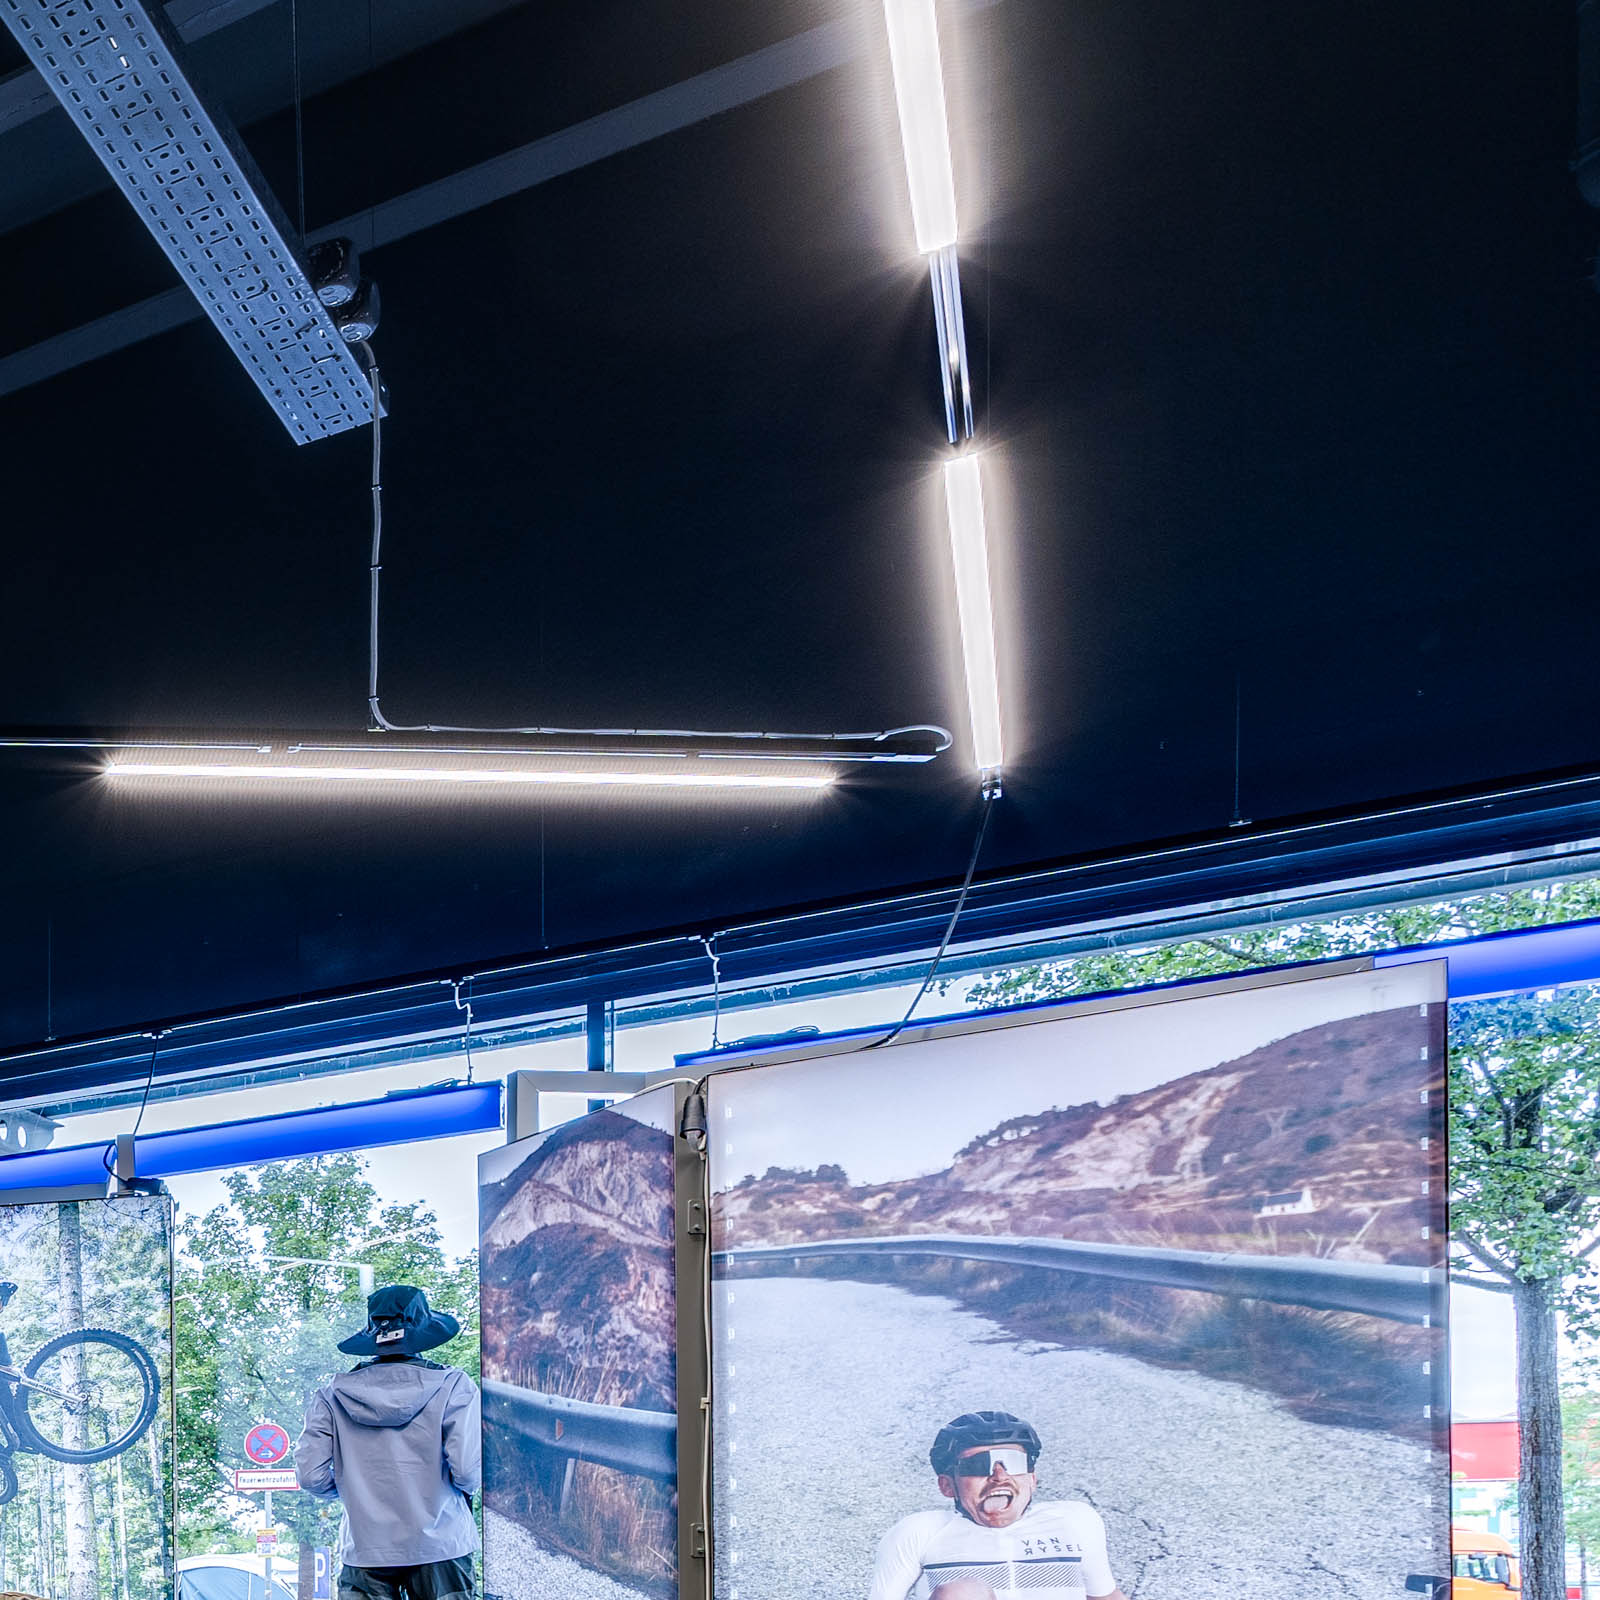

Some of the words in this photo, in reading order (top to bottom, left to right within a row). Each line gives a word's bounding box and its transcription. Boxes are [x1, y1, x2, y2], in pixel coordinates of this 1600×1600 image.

[239, 1474, 297, 1485] Feuerwehrzufahrt
[1021, 1537, 1060, 1546] VAN
[314, 1552, 326, 1593] P
